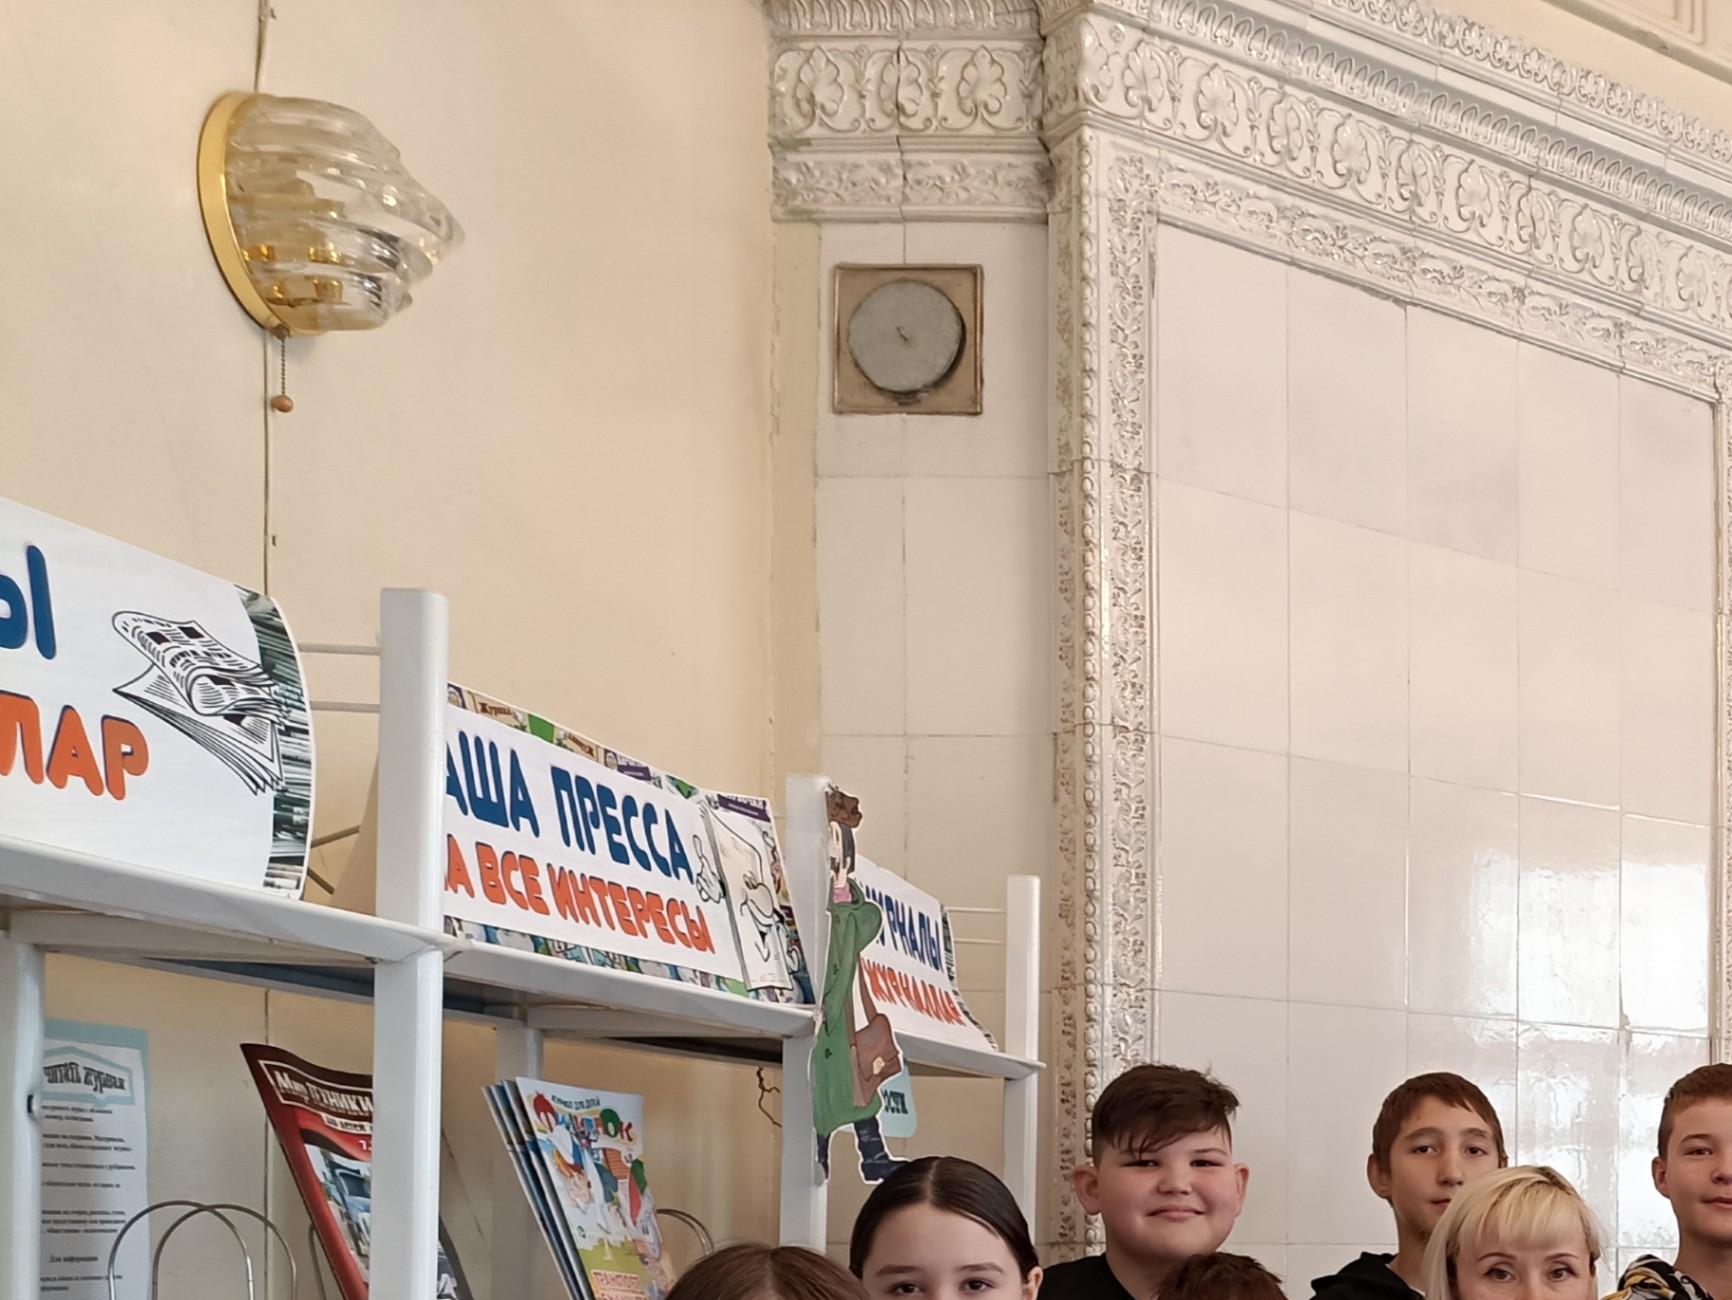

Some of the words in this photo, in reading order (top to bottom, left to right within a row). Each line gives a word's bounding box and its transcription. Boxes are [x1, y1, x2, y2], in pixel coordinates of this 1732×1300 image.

[550, 765, 695, 885] ПРЕССА
[475, 841, 550, 916] ВСЕ
[546, 862, 716, 954] ИНТЕРЕСЫ
